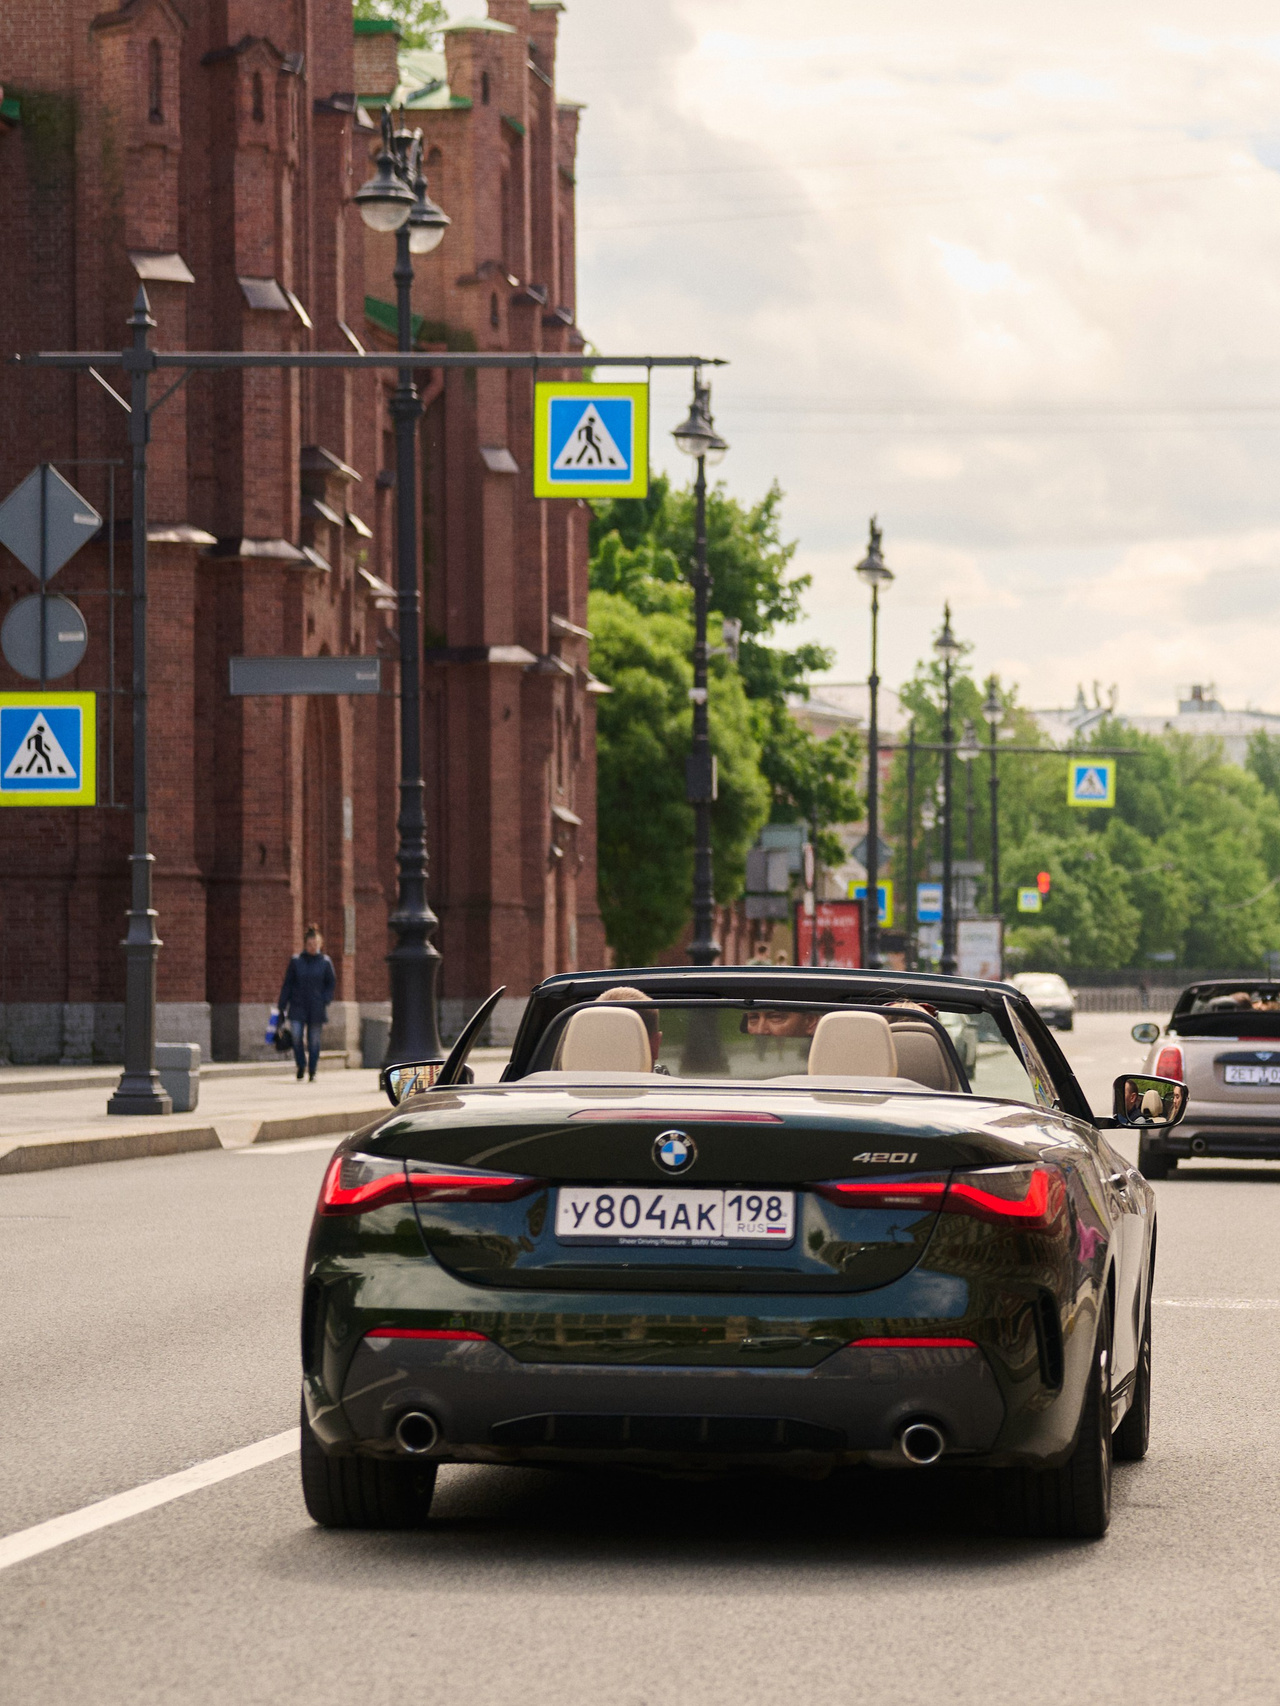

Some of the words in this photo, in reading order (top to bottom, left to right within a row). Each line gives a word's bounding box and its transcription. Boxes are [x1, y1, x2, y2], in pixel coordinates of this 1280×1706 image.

[657, 1133, 692, 1148] BMW
[728, 1195, 782, 1222] 198
[737, 1223, 765, 1233] RUS
